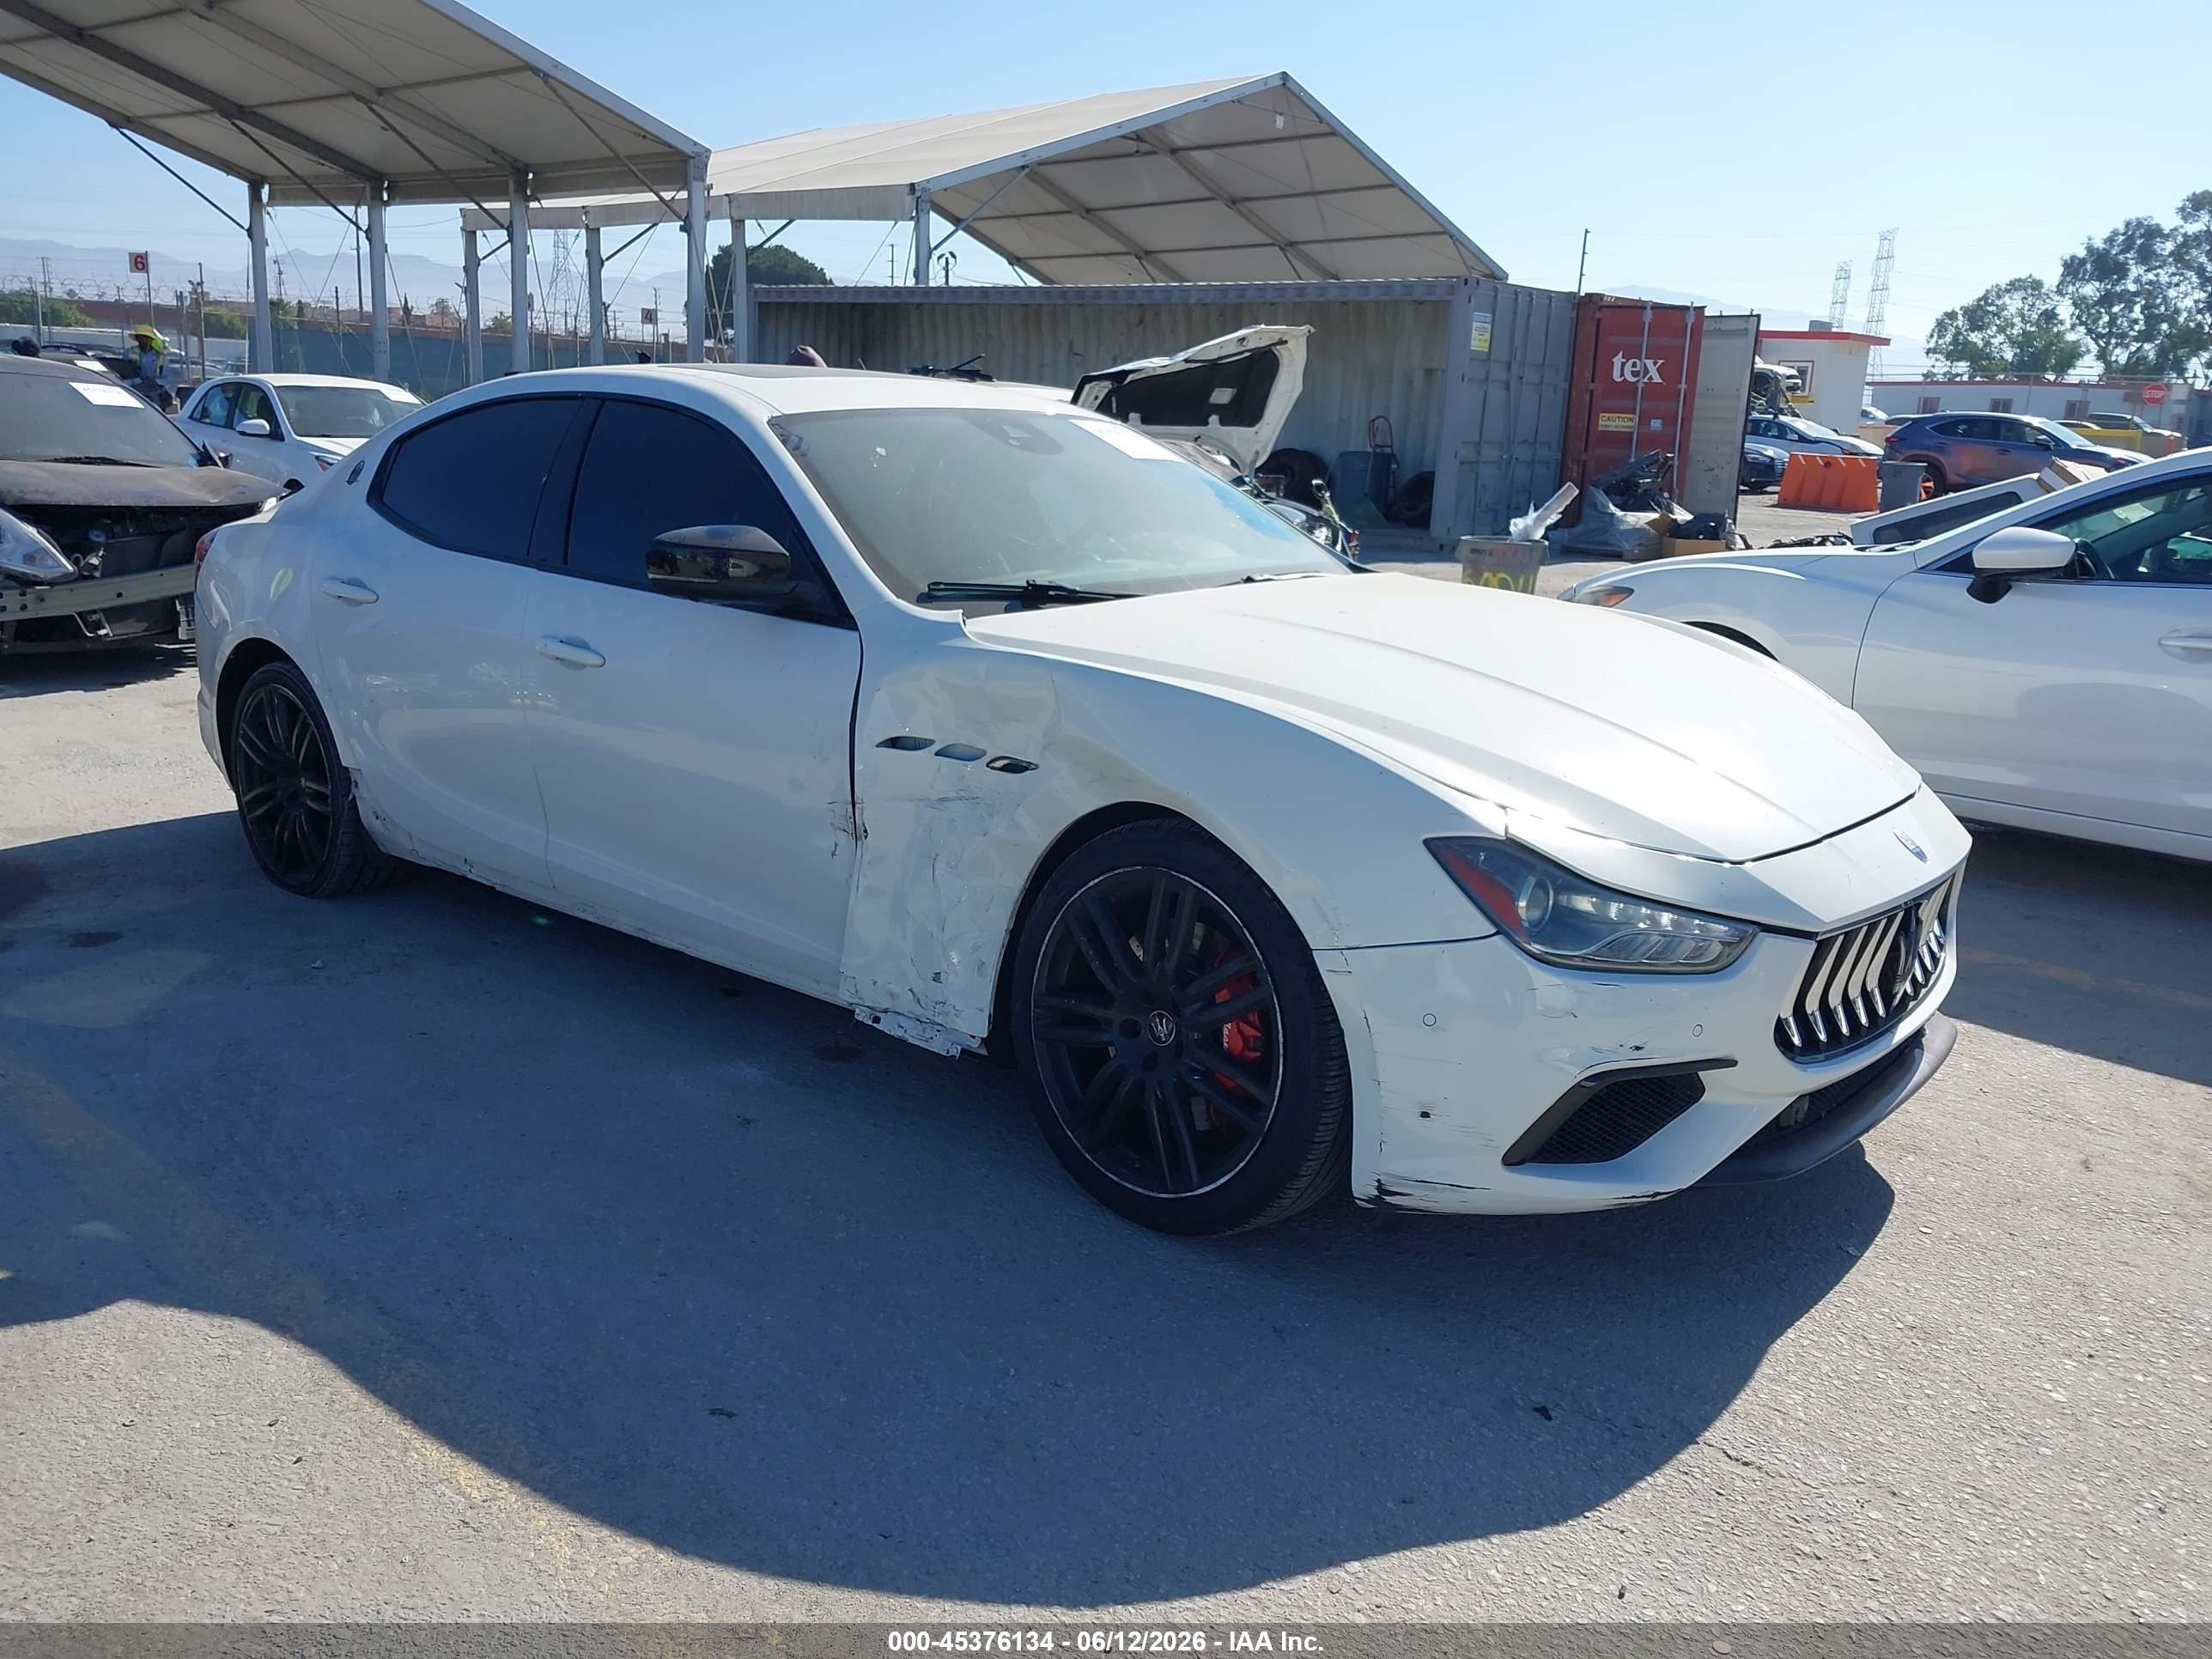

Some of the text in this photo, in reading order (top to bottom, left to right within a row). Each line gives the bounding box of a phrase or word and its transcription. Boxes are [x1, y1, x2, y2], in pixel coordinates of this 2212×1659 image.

[134, 254, 146, 271] 6
[645, 309, 653, 324] 4
[1612, 349, 1666, 383] tex
[2144, 390, 2166, 399] STOP
